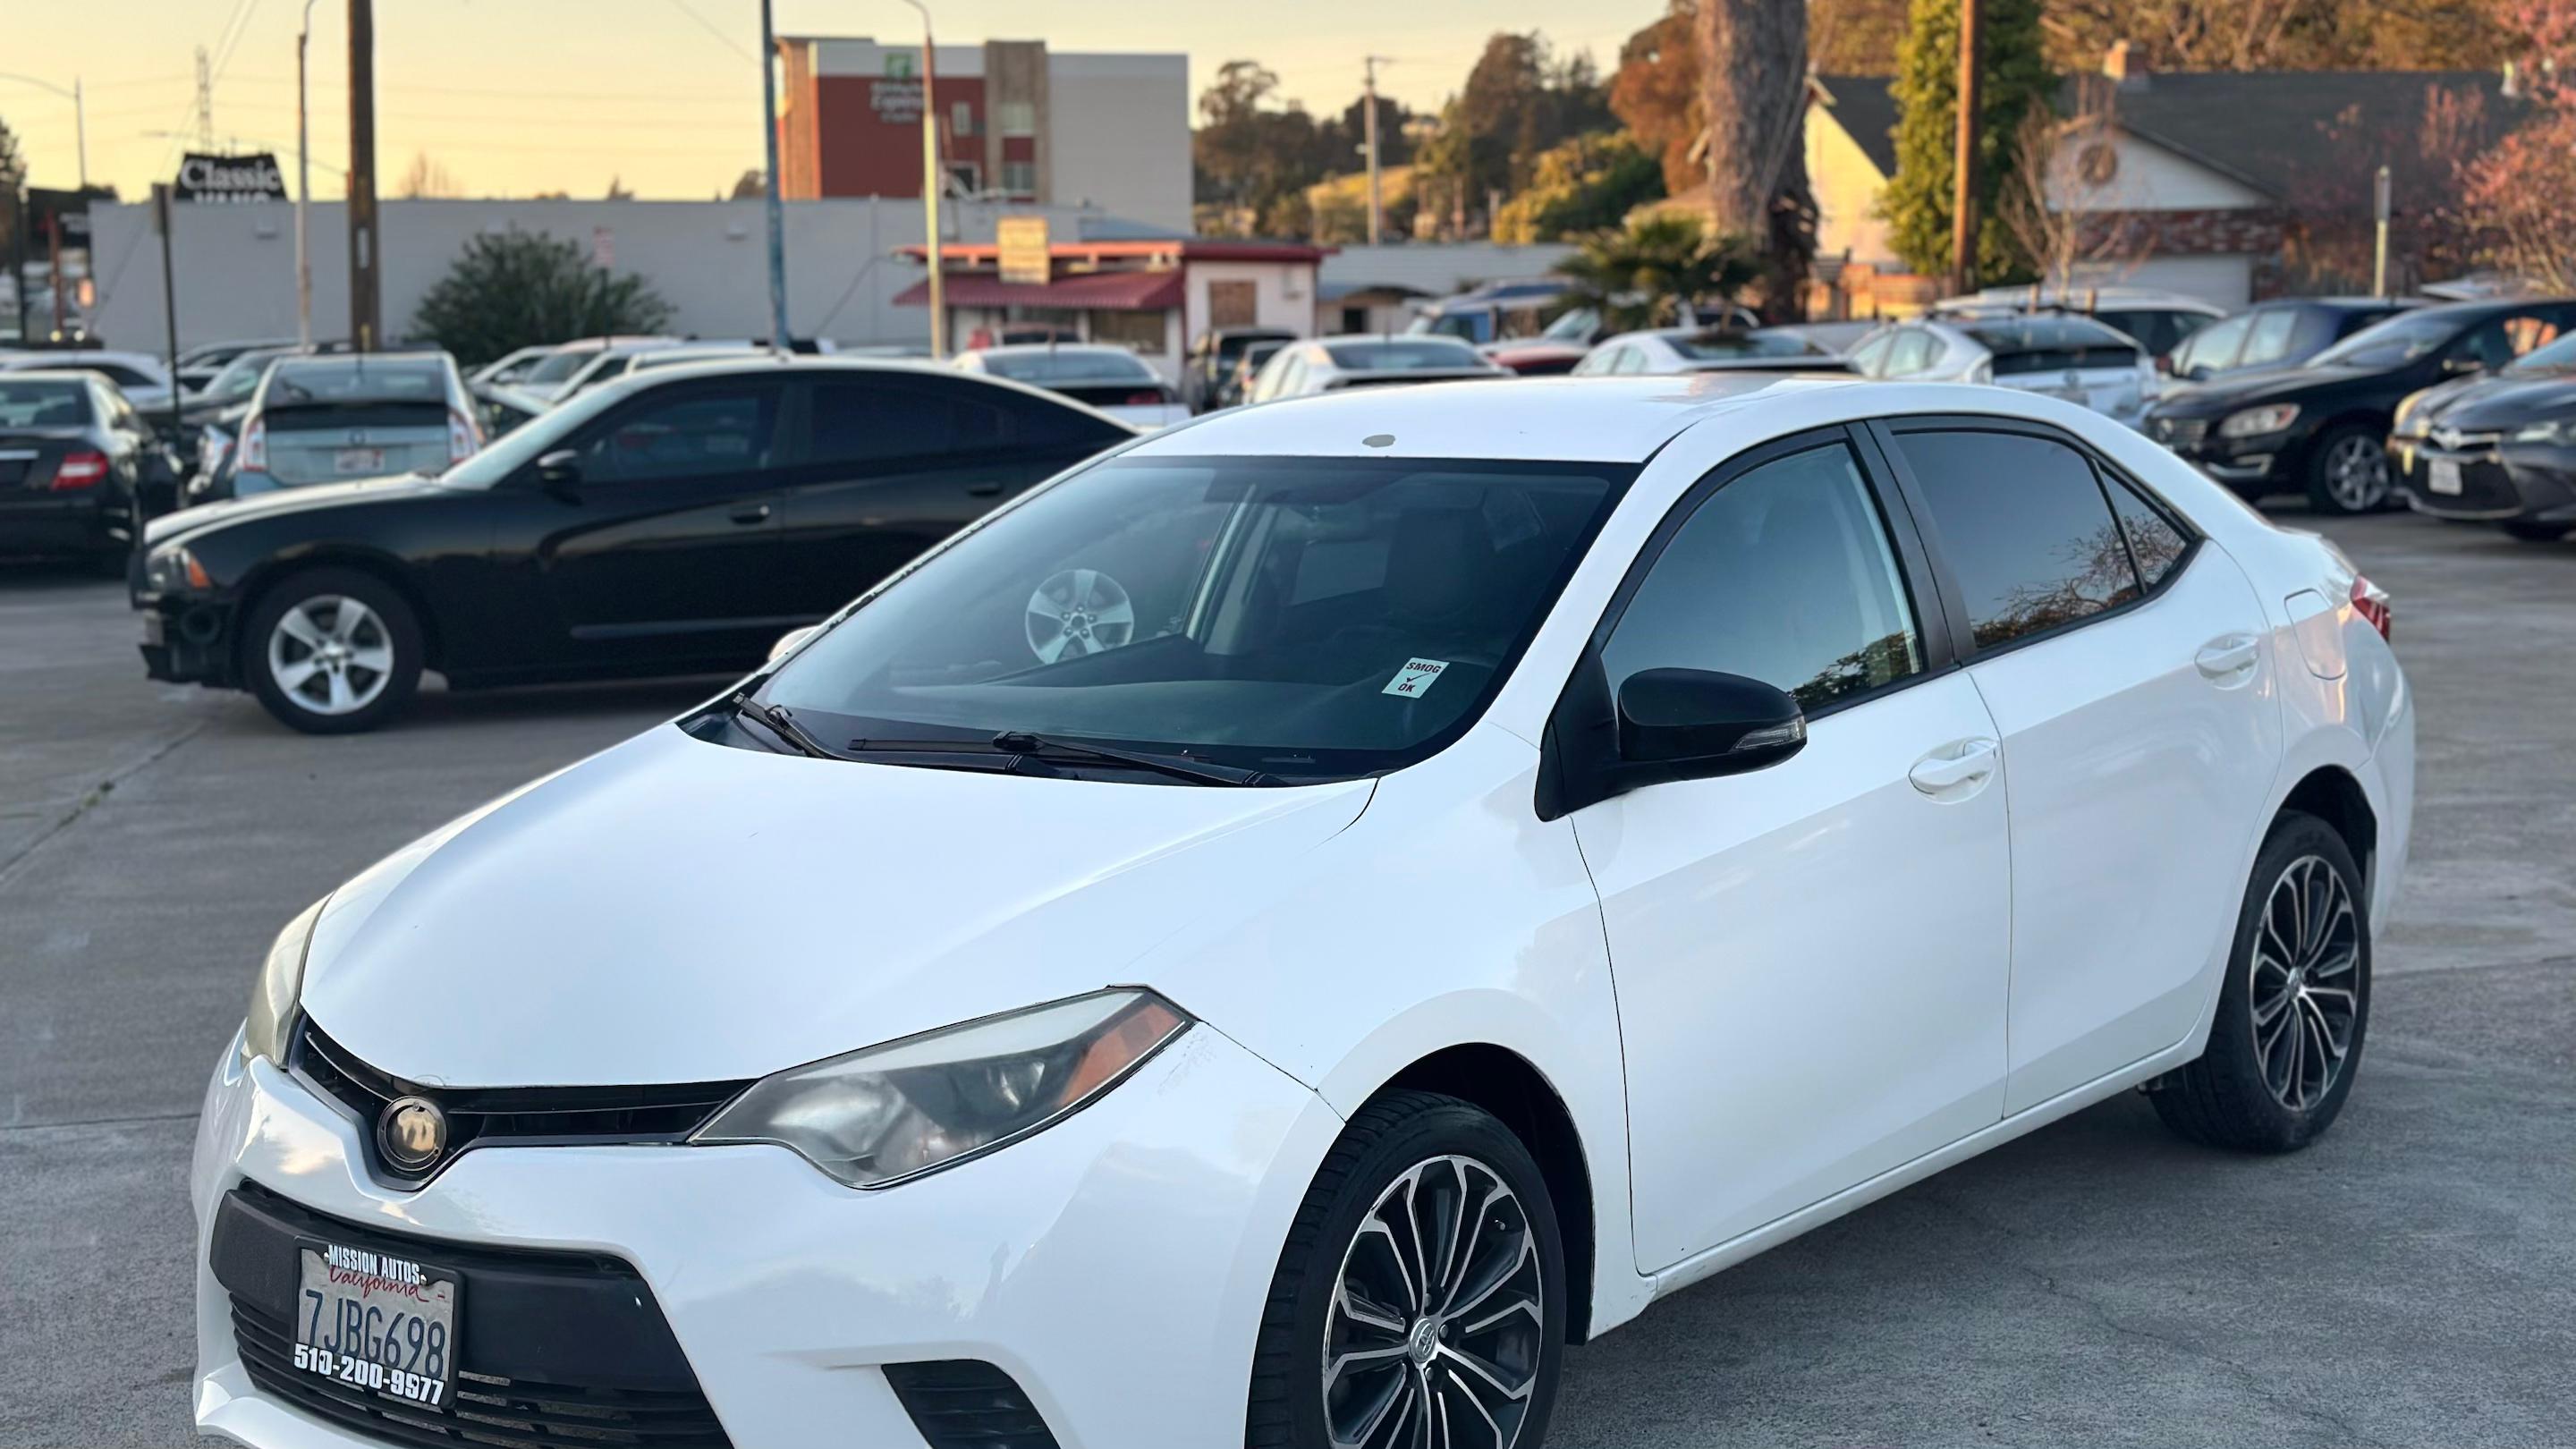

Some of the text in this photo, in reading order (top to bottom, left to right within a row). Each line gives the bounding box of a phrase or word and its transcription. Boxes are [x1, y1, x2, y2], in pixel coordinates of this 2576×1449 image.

[181, 158, 280, 191] Classic
[1407, 662, 1441, 674] SMOG
[1398, 683, 1416, 692] OK
[328, 1244, 419, 1285] MISSION AUTOS
[330, 1266, 429, 1302] California
[305, 1289, 445, 1379] 7JBG698
[293, 1343, 445, 1405] 510-200-9977
